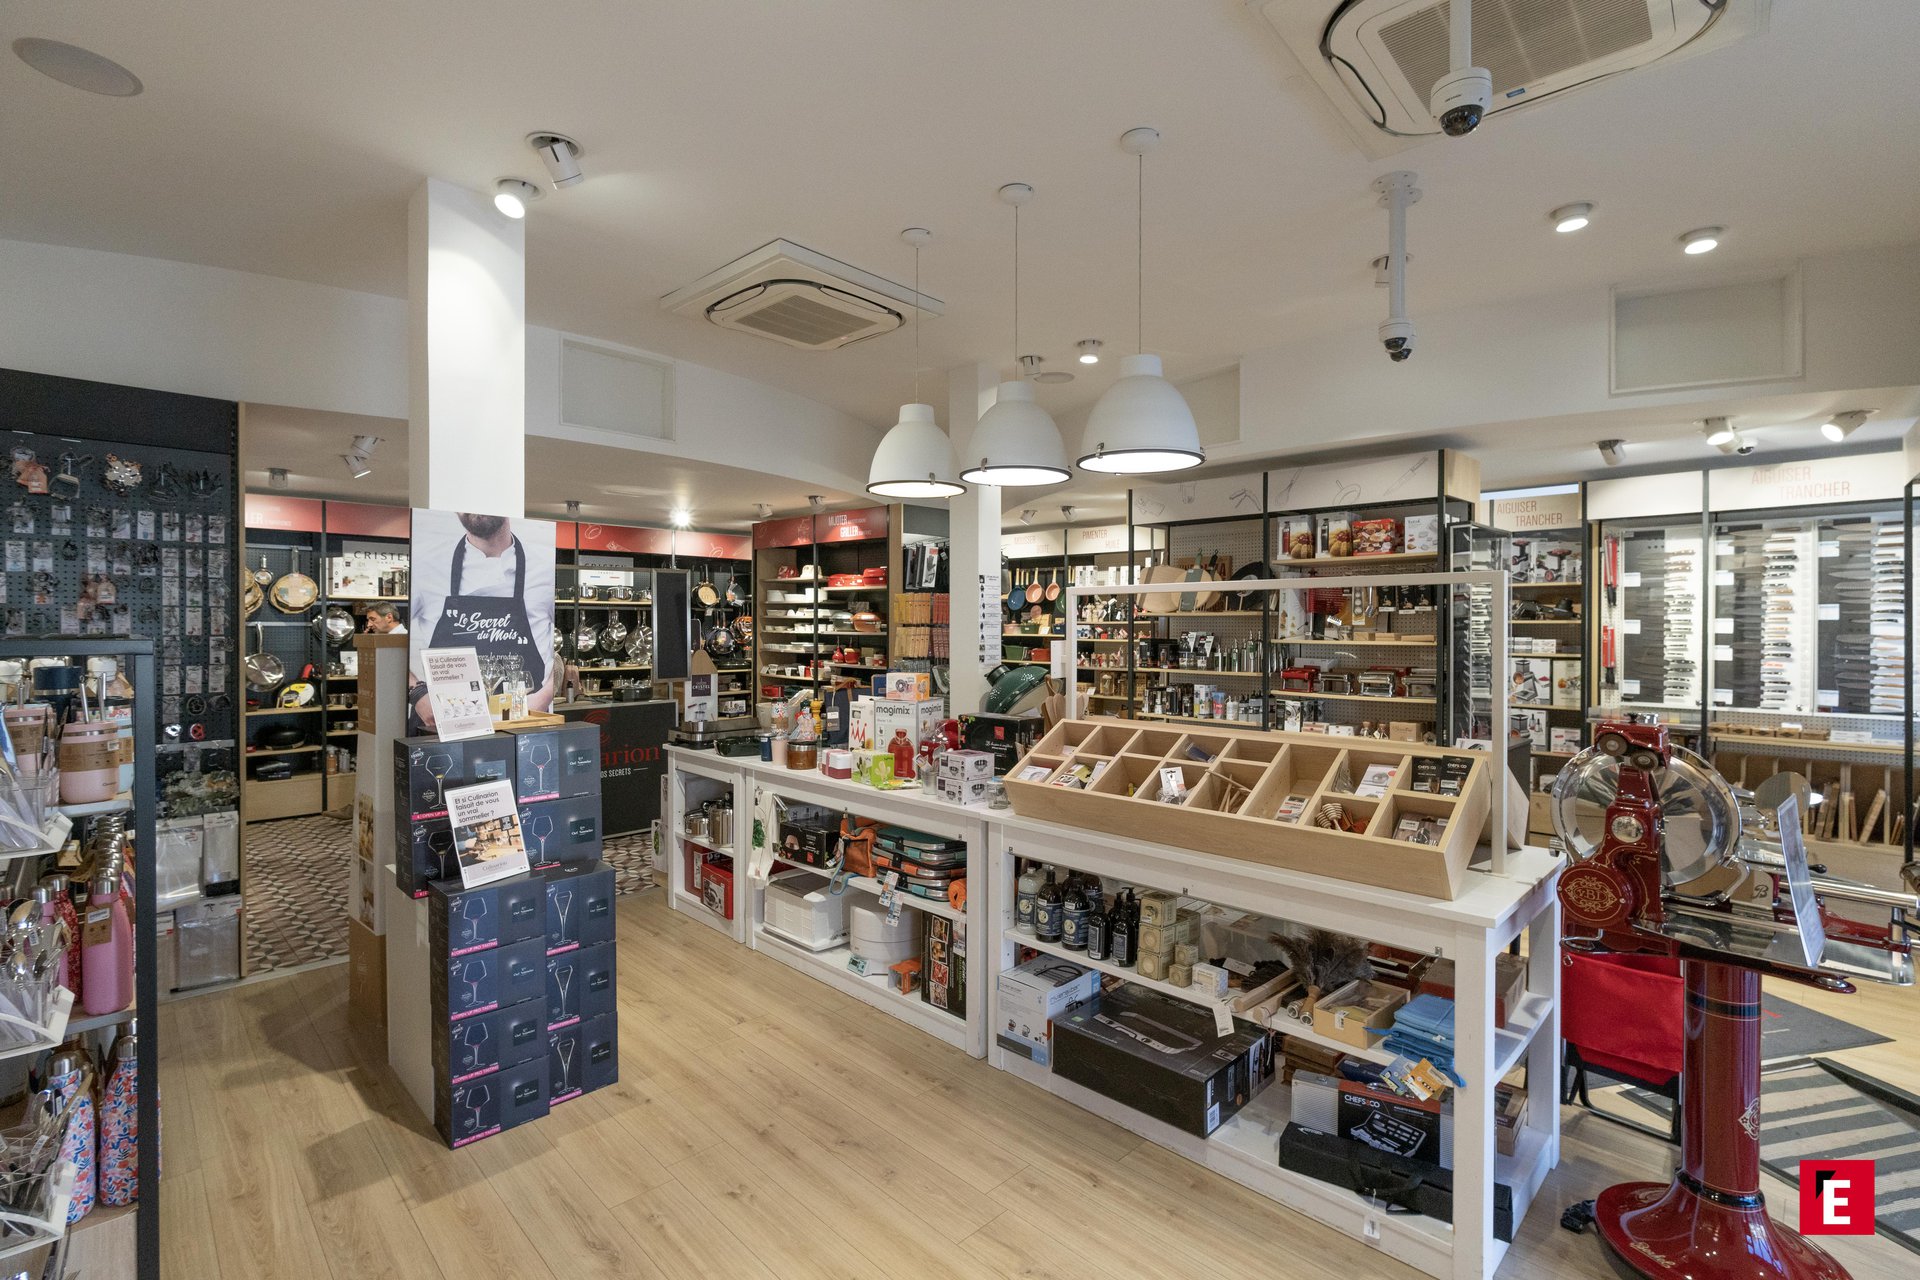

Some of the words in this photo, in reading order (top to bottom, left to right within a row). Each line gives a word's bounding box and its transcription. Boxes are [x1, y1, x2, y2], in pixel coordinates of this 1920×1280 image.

[1752, 465, 1811, 485] AIGUISER
[1780, 480, 1850, 500] TRANCHER
[1497, 500, 1537, 514] AIGUISER
[1516, 512, 1563, 527] TRANCHER
[1082, 528, 1108, 540] PIMENTER
[453, 613, 469, 628] Le
[466, 612, 511, 631] Secret
[477, 631, 491, 641] du
[488, 628, 518, 643] Mois
[876, 705, 910, 716] magimix
[920, 704, 942, 716] magimix
[609, 767, 632, 778] SECRETS
[467, 791, 499, 802] Culinarion
[456, 802, 475, 812] faisait
[485, 798, 500, 806] vous
[467, 807, 479, 815] vrai
[458, 812, 490, 824] sommelier
